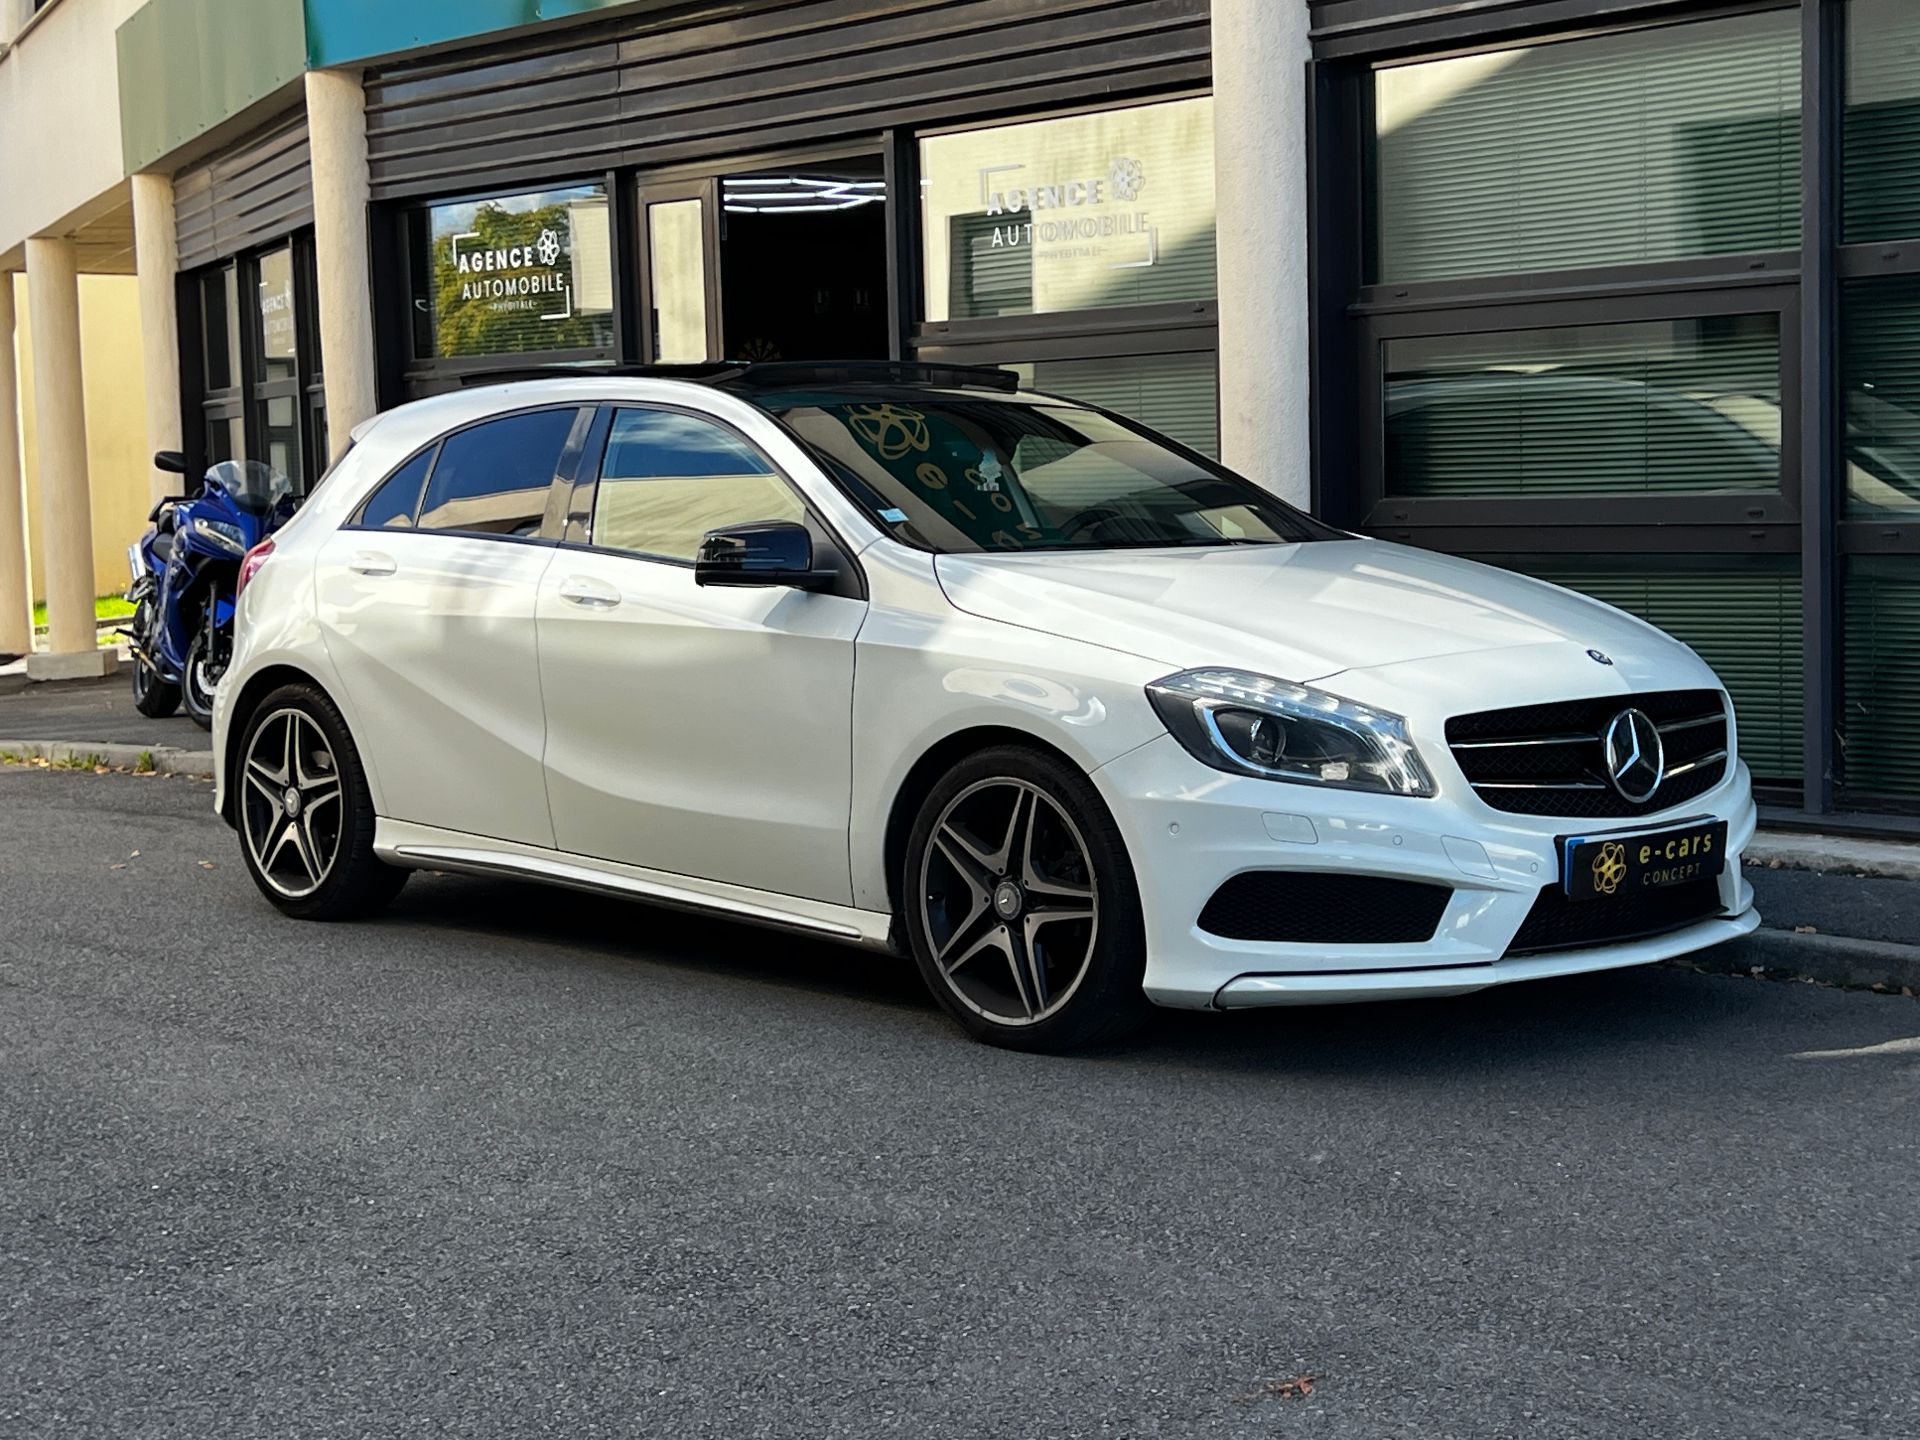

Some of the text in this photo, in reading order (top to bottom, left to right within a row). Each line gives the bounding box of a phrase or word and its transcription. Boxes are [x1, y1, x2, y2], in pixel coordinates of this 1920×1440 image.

[986, 180, 1104, 216] AGENCE
[991, 212, 1150, 248] AUTOMOBILE
[458, 246, 534, 274] AGENCE
[461, 272, 564, 300] AUTOMOBILE
[1639, 833, 1712, 864] e-cars
[1643, 862, 1701, 885] CONCEPT
